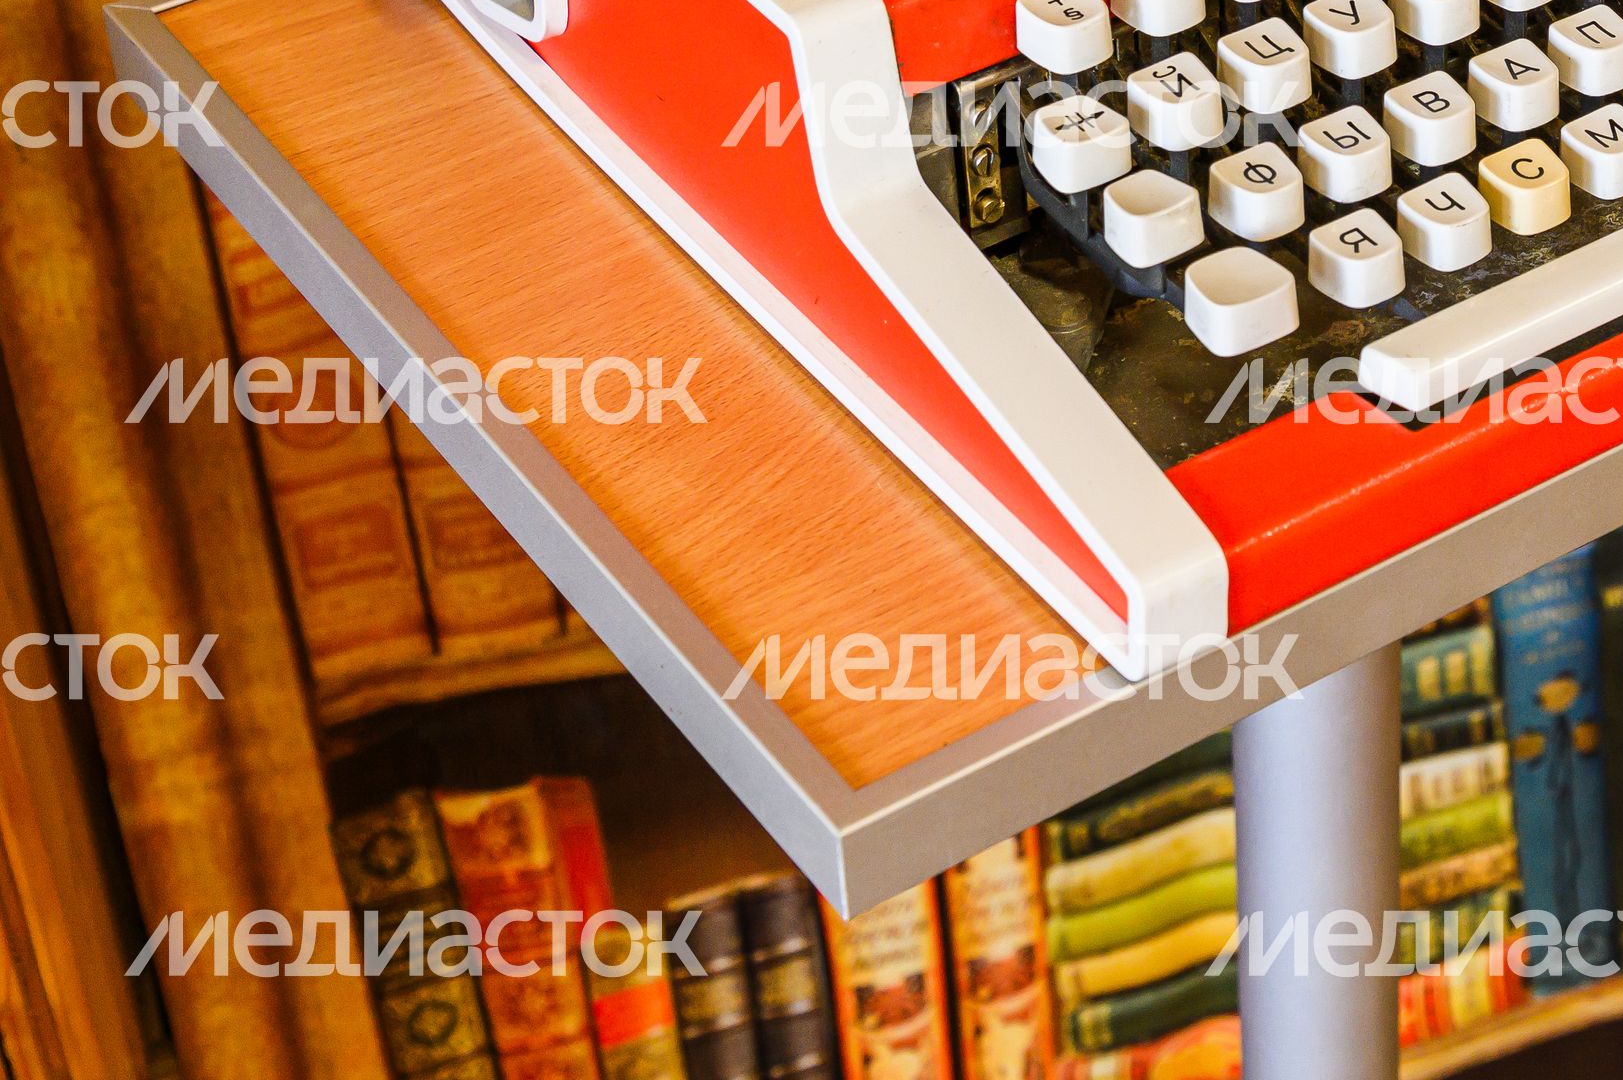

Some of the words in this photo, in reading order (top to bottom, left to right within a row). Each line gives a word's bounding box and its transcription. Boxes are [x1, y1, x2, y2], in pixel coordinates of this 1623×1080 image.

[1328, 0, 1361, 26] У
[1575, 20, 1617, 45] П
[1244, 34, 1296, 60] Ц
[1152, 64, 1202, 99] Й
[1503, 57, 1541, 81] А
[1412, 90, 1451, 113] В
[1322, 120, 1372, 150] Ы
[1242, 160, 1278, 186] Ф
[1511, 157, 1546, 181] С
[1424, 190, 1467, 212] Ч
[1338, 226, 1379, 254] Я
